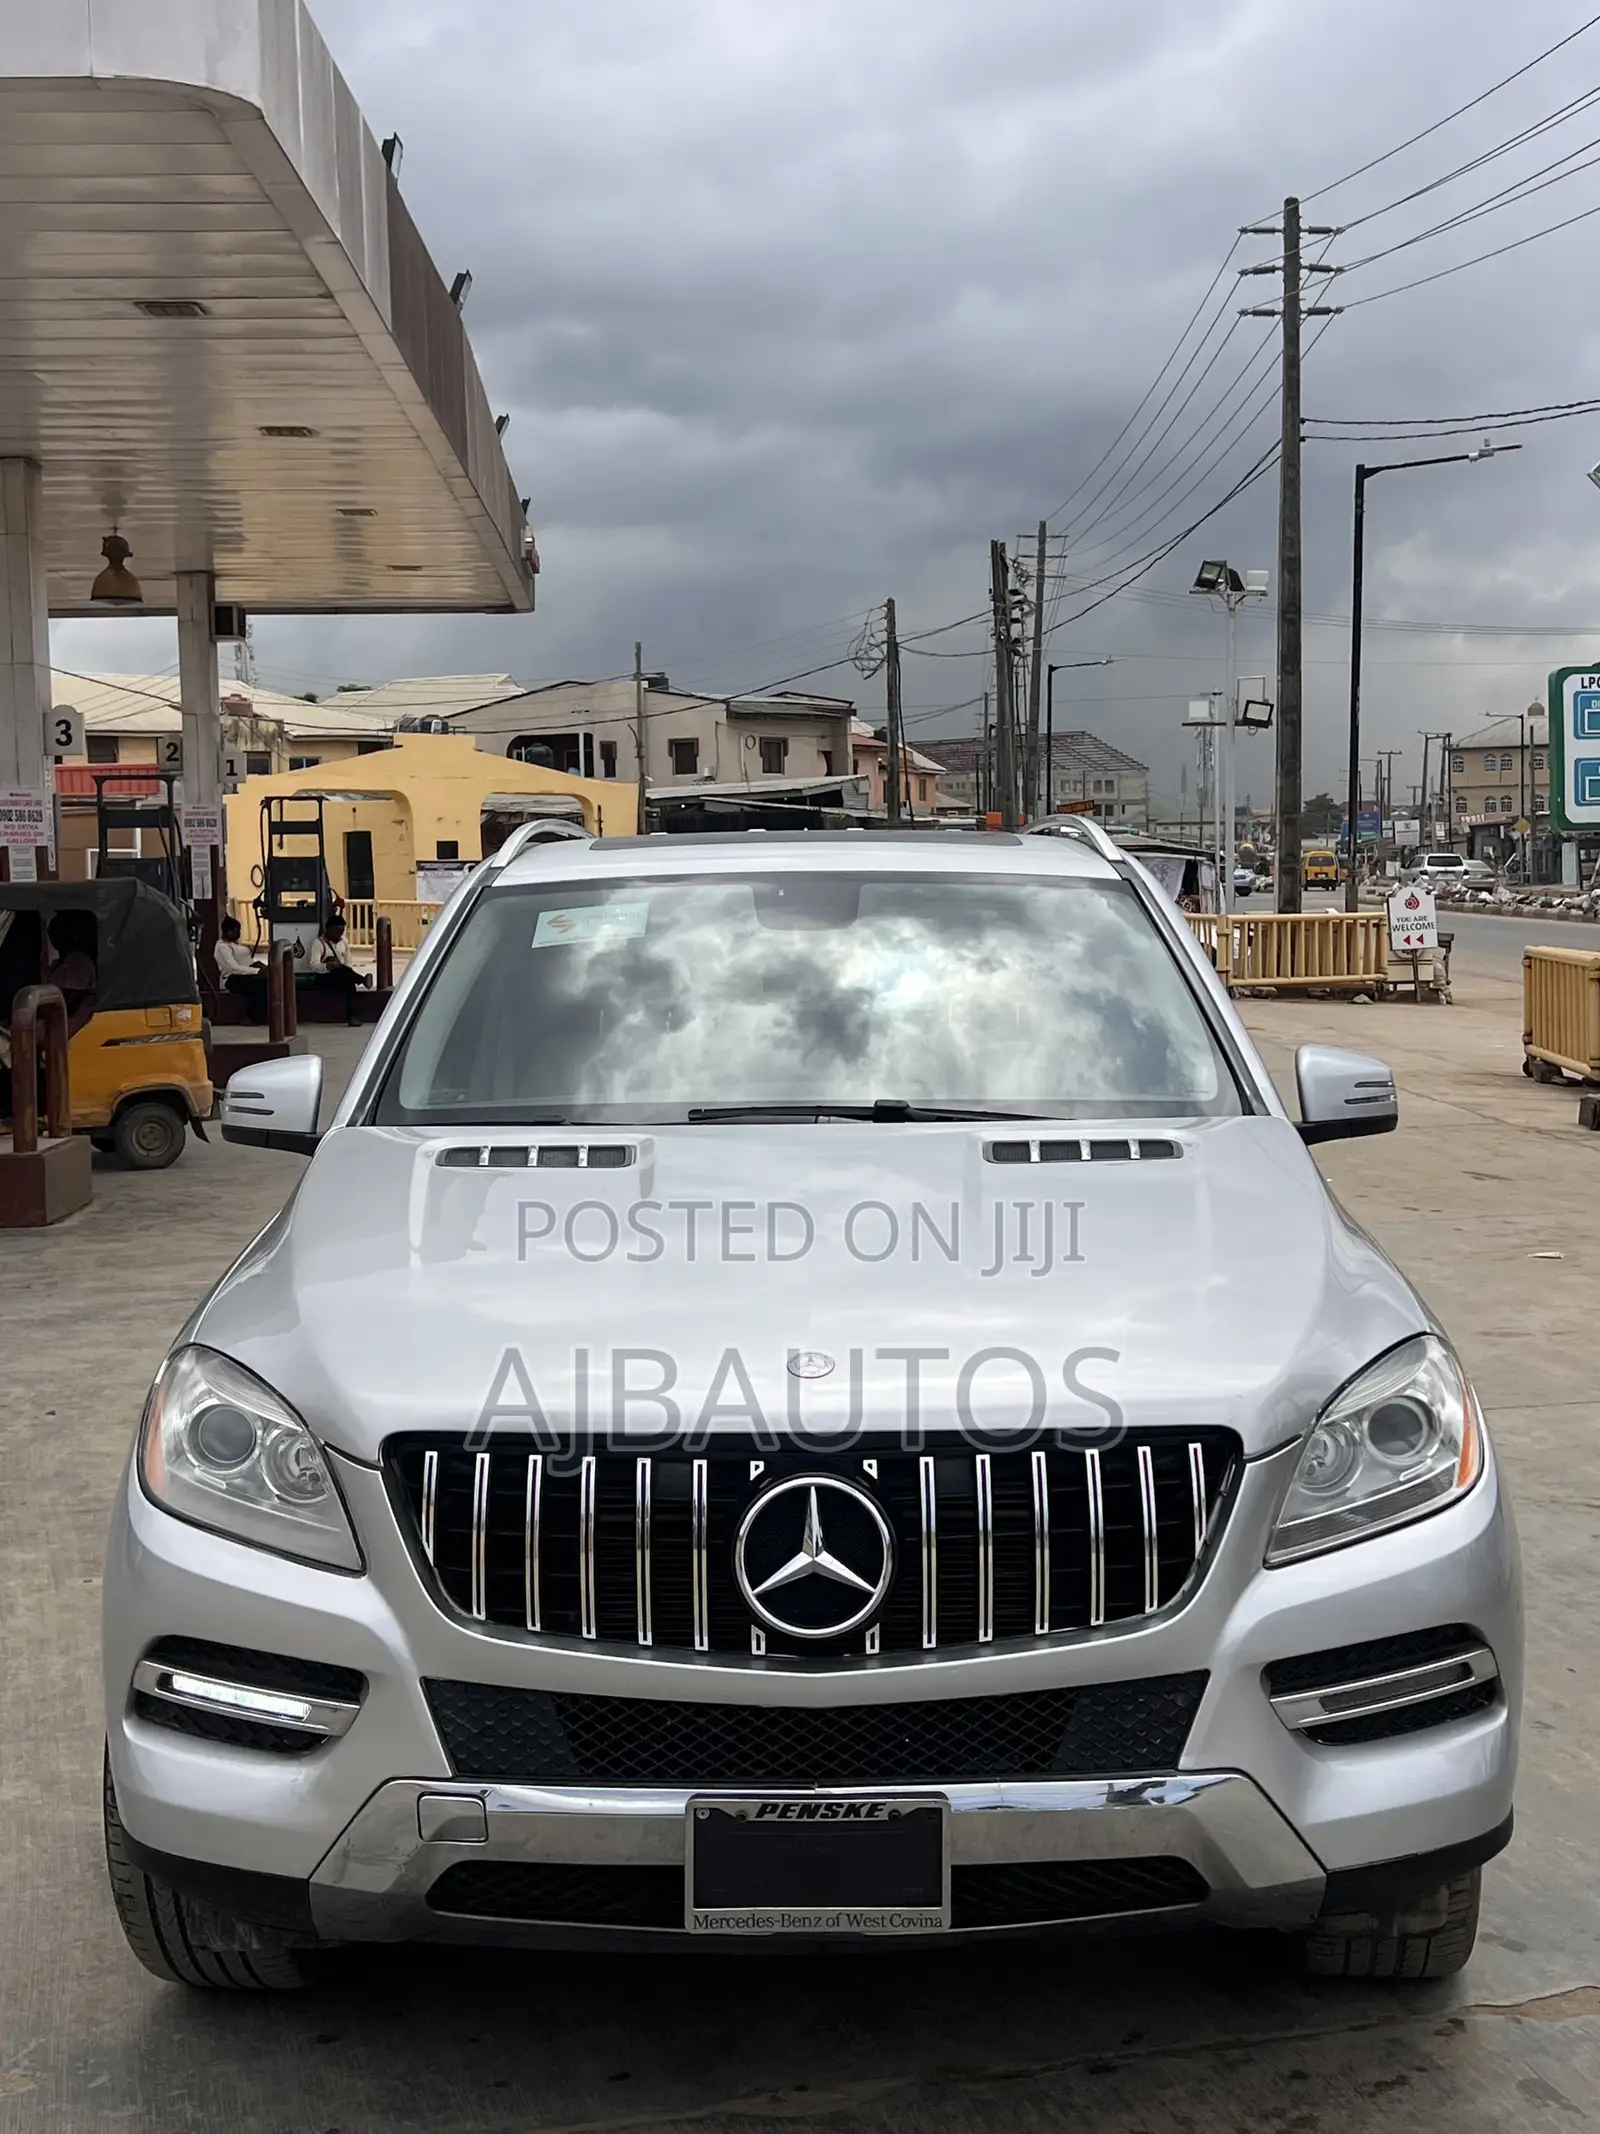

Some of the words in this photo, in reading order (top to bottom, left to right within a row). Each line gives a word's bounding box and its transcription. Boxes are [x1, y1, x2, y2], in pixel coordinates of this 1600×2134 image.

[55, 719, 73, 747] 3
[166, 742, 180, 762] 2
[225, 759, 238, 777] 1
[1392, 921, 1436, 932] WELCOME
[755, 1802, 887, 1820] PENSKE
[692, 1913, 822, 1930] Mercedes-Benz
[826, 1912, 842, 1928] of
[844, 1913, 886, 1928] West
[889, 1912, 943, 1929] Covina
